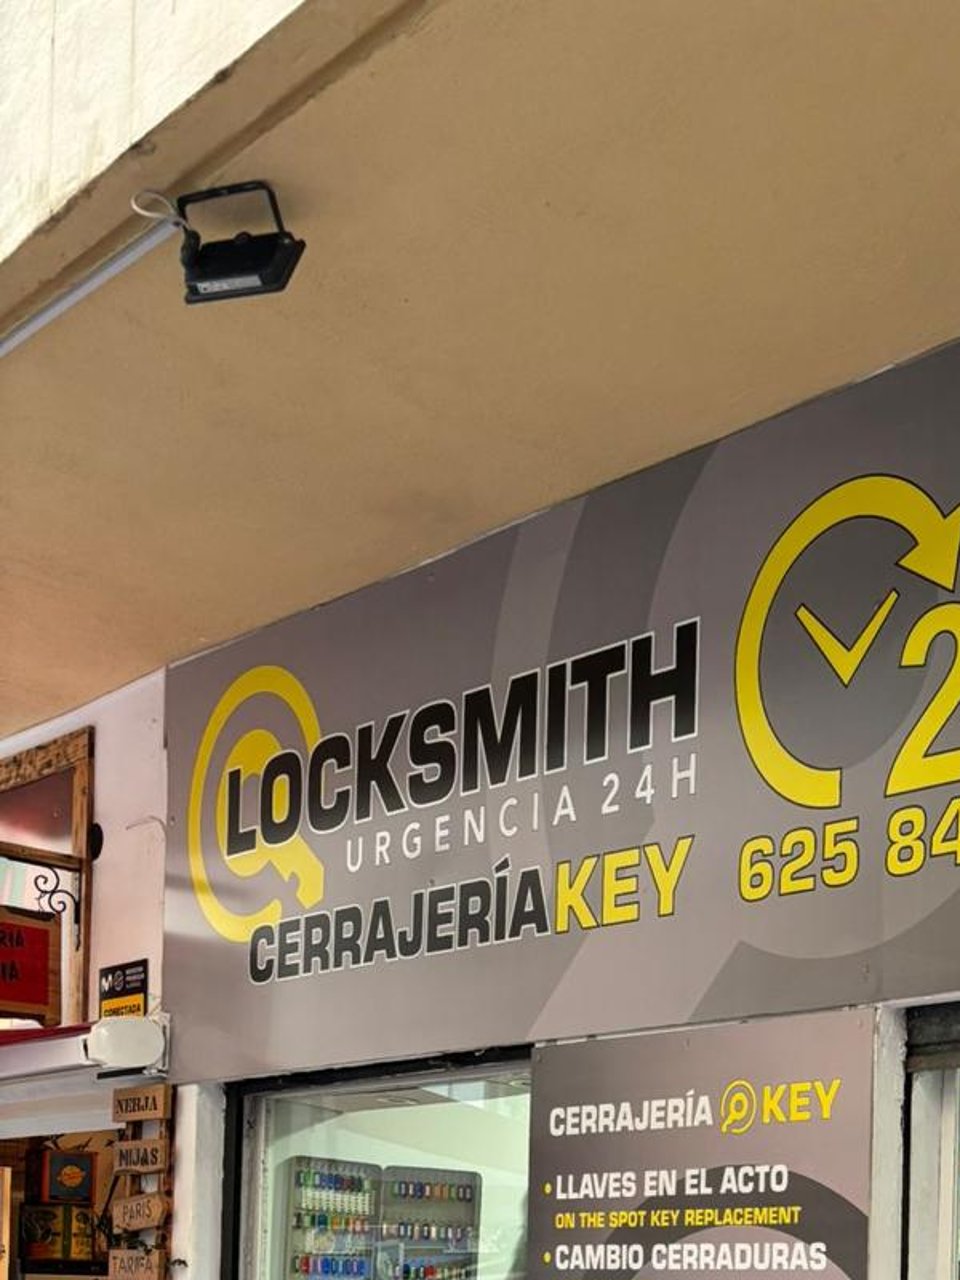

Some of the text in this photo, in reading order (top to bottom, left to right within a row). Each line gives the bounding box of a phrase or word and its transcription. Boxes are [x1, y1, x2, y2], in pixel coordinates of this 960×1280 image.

[225, 616, 700, 858] LOCKSMITH
[346, 753, 697, 872] URGENCIA 24H
[738, 817, 859, 901] 625
[115, 1095, 158, 1114] NERJA
[549, 1079, 841, 1137] CERRAJERÍA KEY
[556, 1164, 789, 1200] LLAVES EN EL ACTO
[122, 1199, 153, 1222] PARIS
[555, 1206, 802, 1229] ON THE SPOT KEY REPLACEMENT
[112, 1255, 153, 1274] TARIFA
[555, 1242, 828, 1271] CAMBIO CERRADURAS
